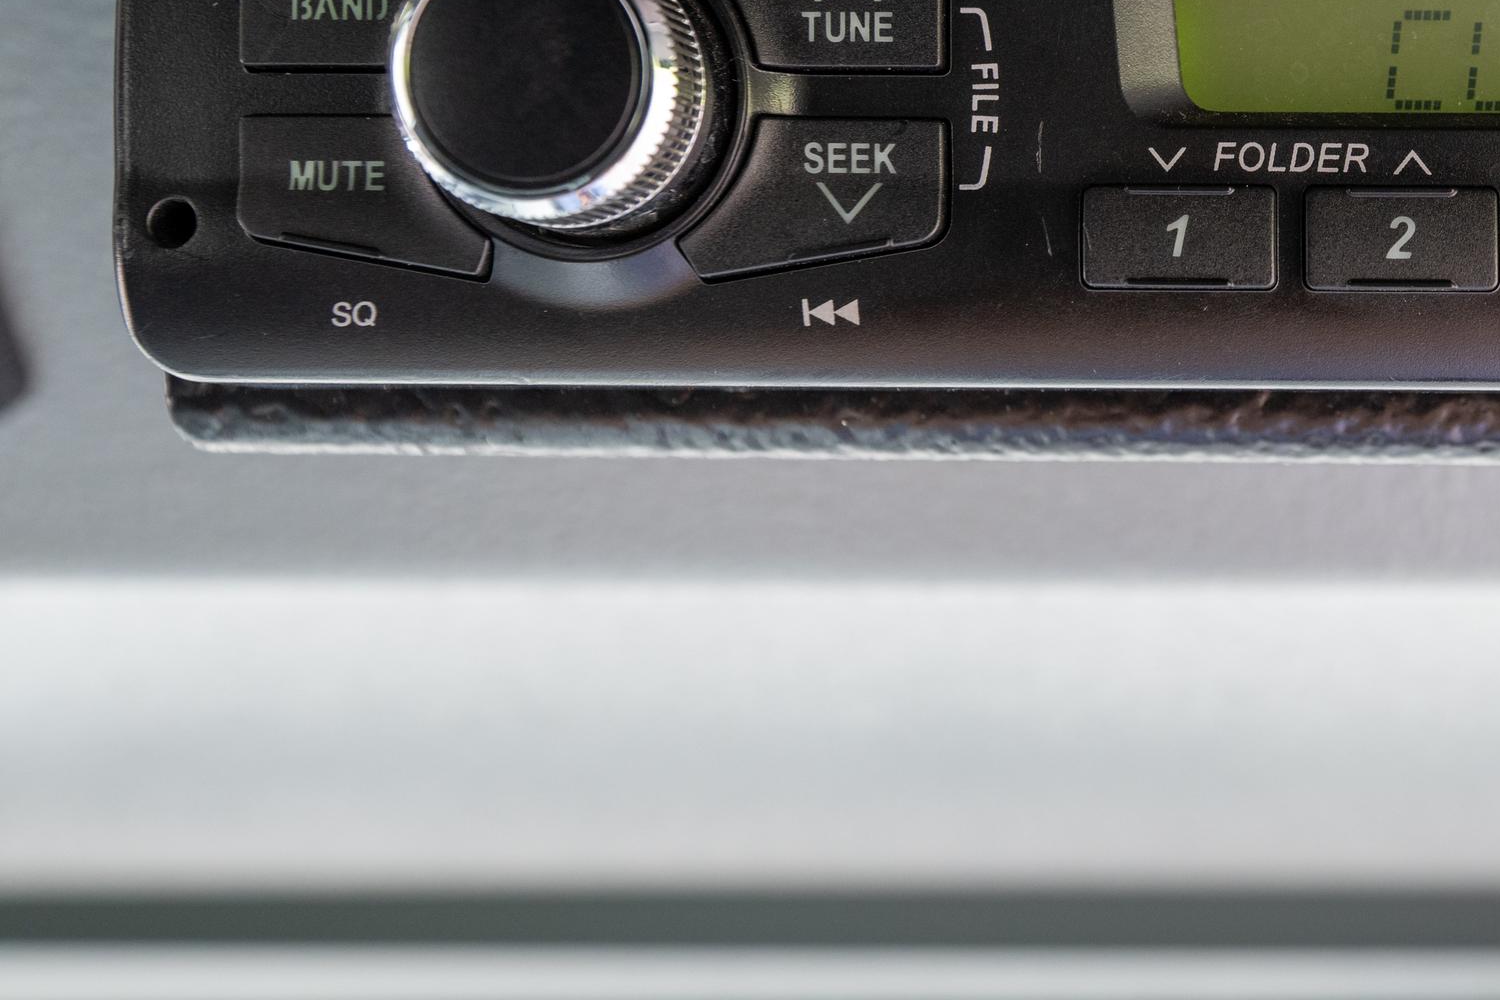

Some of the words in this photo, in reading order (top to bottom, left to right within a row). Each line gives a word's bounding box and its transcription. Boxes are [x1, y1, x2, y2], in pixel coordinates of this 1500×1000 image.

[801, 11, 894, 43] TUNE
[970, 62, 1000, 134] FILE
[803, 141, 897, 175] SEEK
[1213, 141, 1370, 173] FOLDER
[289, 159, 385, 191] MUTE
[1166, 214, 1190, 258] 1
[1385, 215, 1416, 260] 2
[331, 300, 378, 328] SQ
